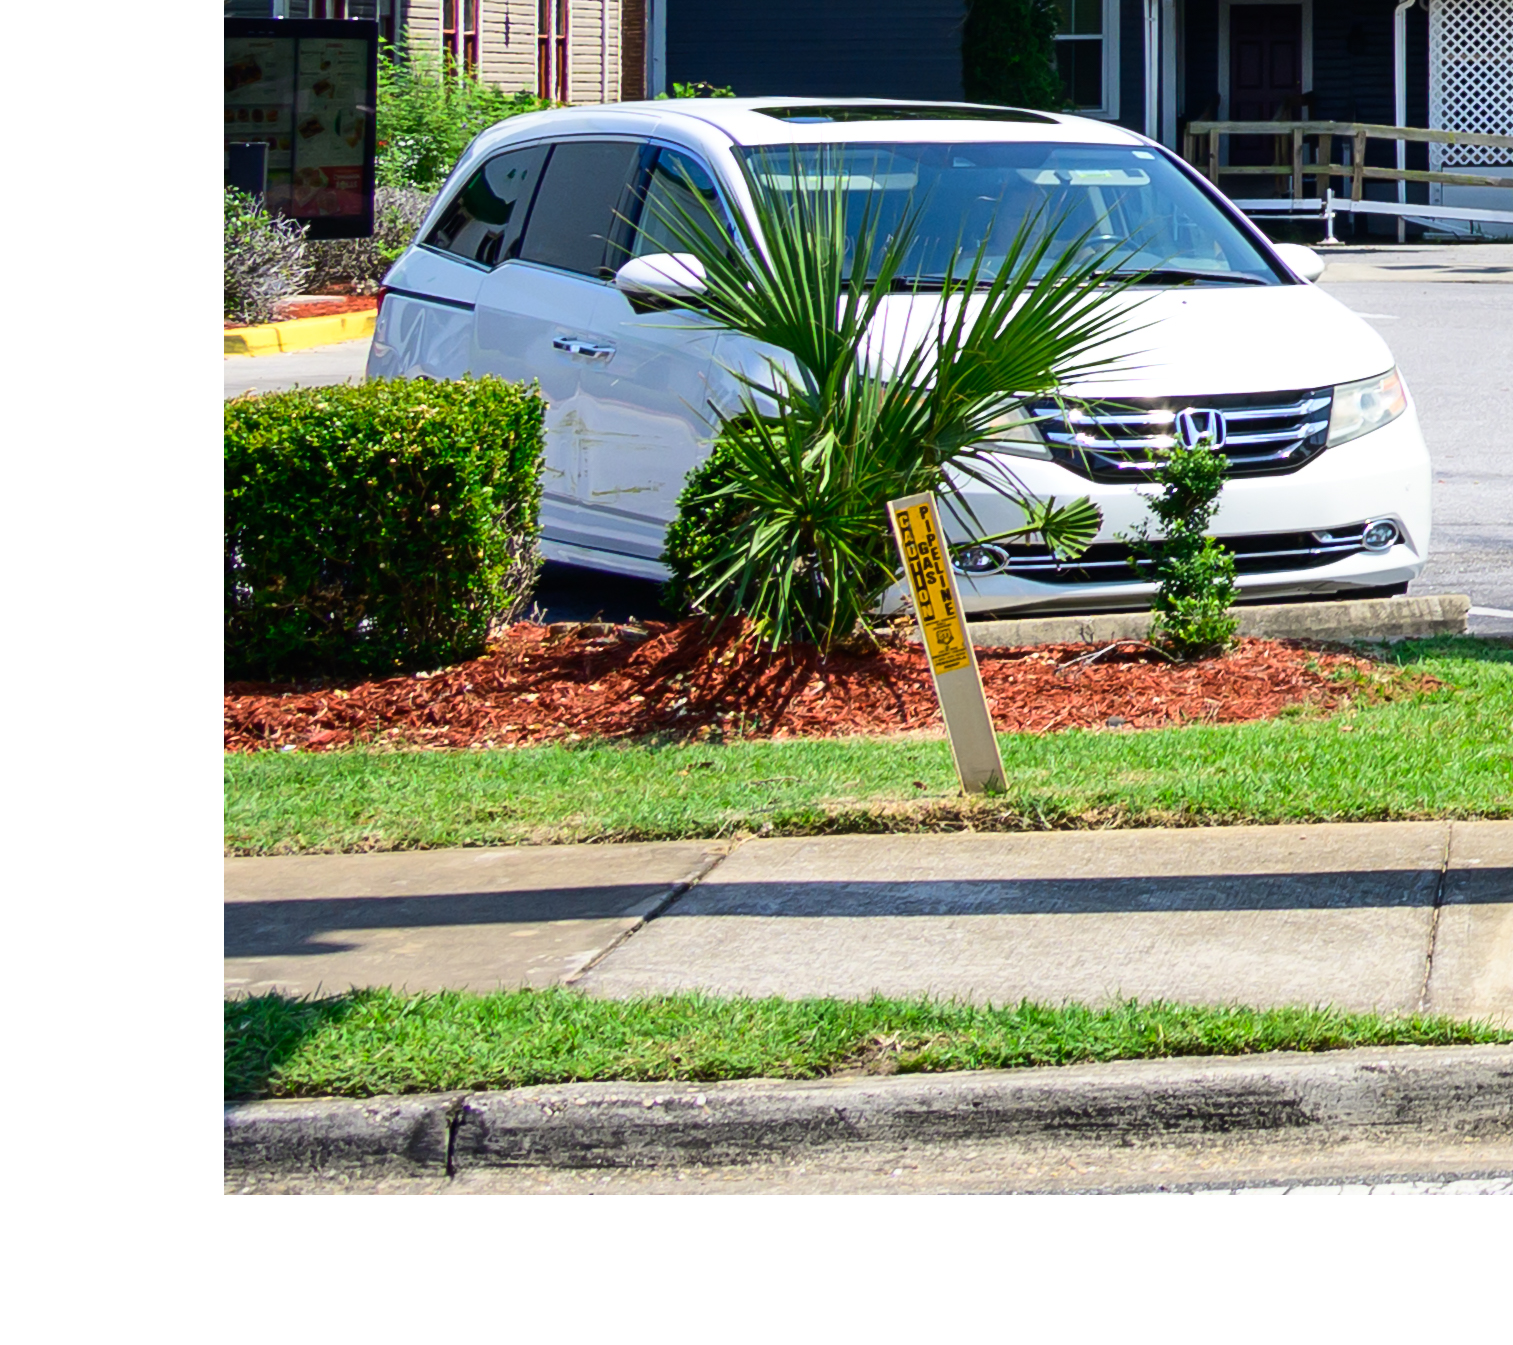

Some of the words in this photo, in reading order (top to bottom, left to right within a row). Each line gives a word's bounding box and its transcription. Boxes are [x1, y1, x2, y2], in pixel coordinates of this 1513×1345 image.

[896, 510, 936, 622] CAUTION
[918, 541, 937, 585] GAS
[919, 505, 956, 617] PIPELINE
